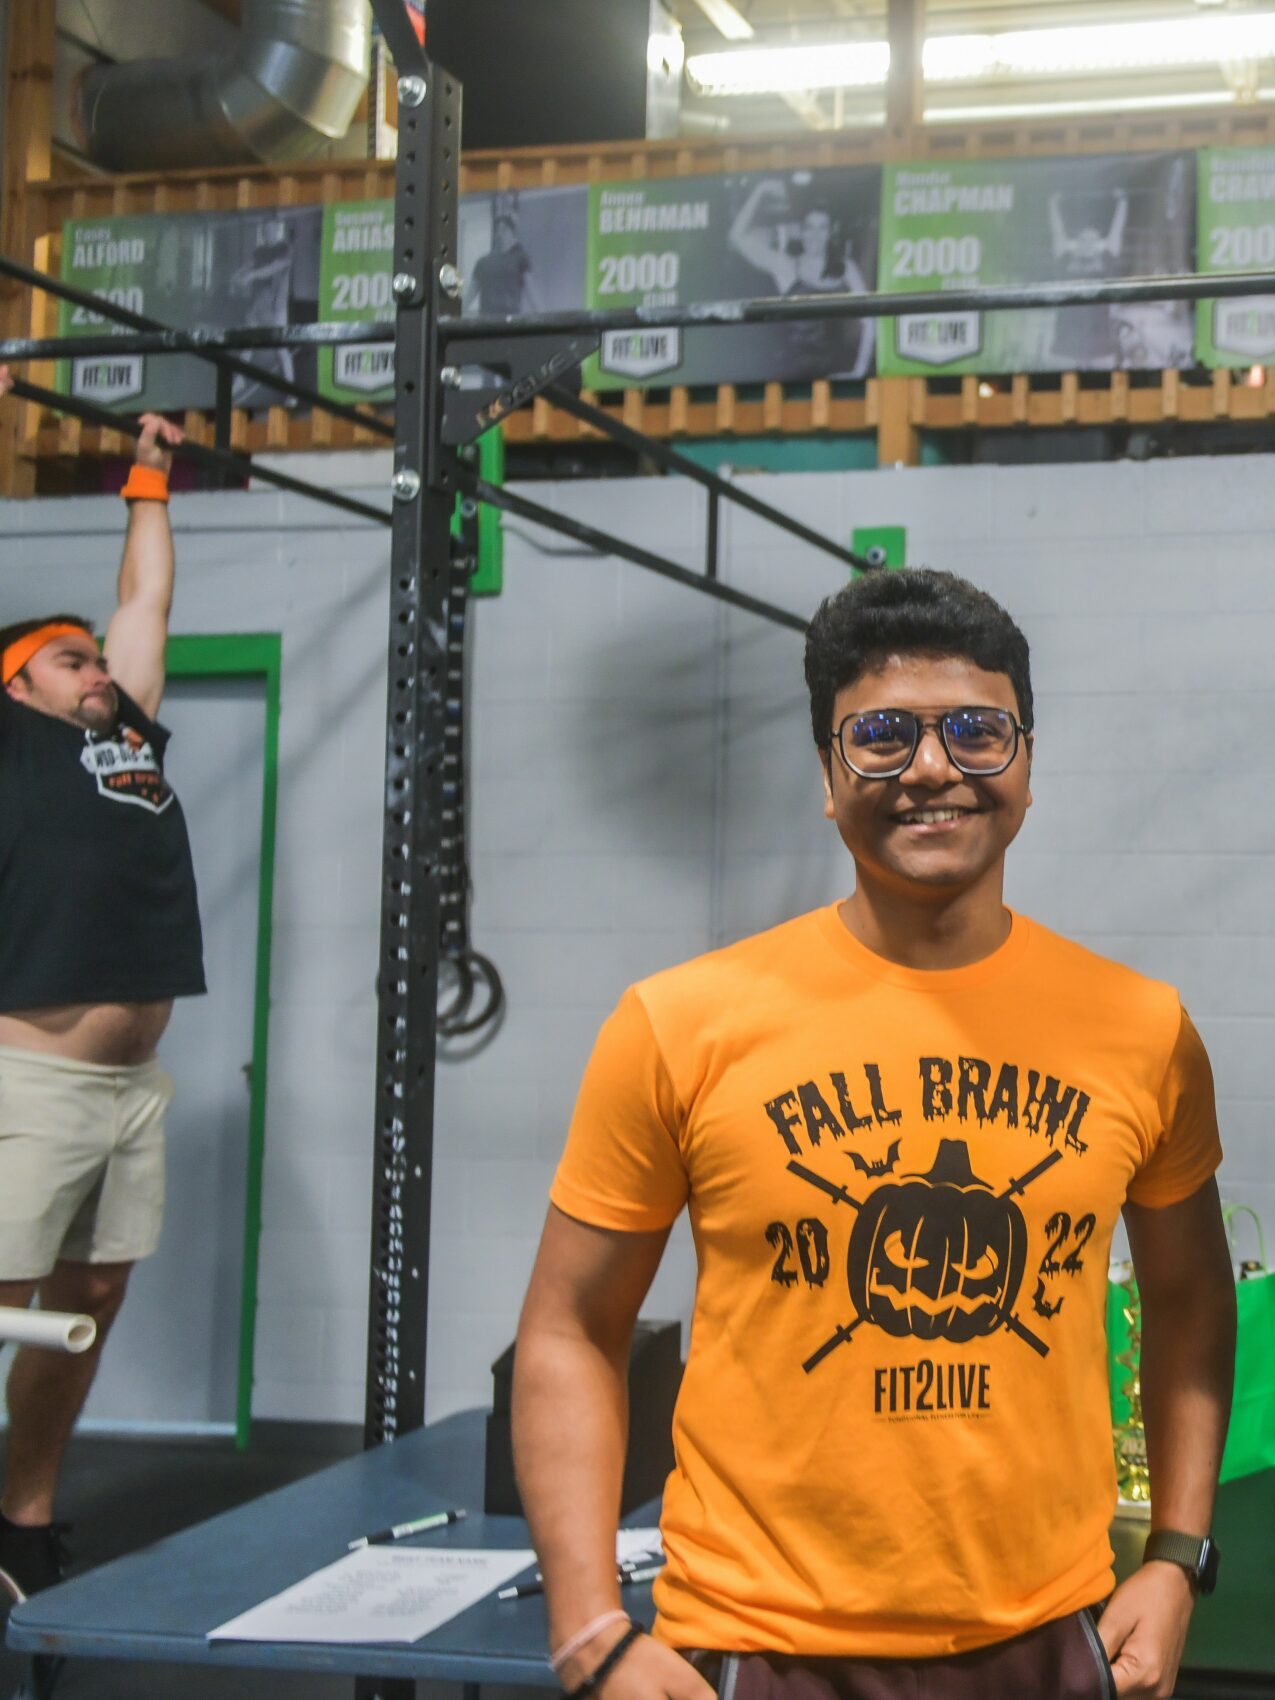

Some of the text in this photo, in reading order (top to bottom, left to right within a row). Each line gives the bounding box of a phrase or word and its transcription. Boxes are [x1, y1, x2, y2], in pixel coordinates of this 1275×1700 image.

[894, 184, 1014, 216] CHAPMAN
[600, 203, 710, 235] BEHRMAN
[72, 238, 145, 268] ALFORD
[332, 224, 396, 254] ARIAS
[893, 235, 981, 279] 2000
[599, 253, 680, 294] 2000
[344, 349, 394, 376] FIT2LIV
[612, 333, 668, 361] FIT2LIVE
[82, 363, 133, 389] FIT2LIVE
[763, 1055, 1092, 1157] FALL BRAWL
[764, 1217, 831, 1289] 20
[1039, 1211, 1097, 1277] 22
[874, 1359, 991, 1413] FIT2LIVE
[1120, 1437, 1147, 1455] 202
